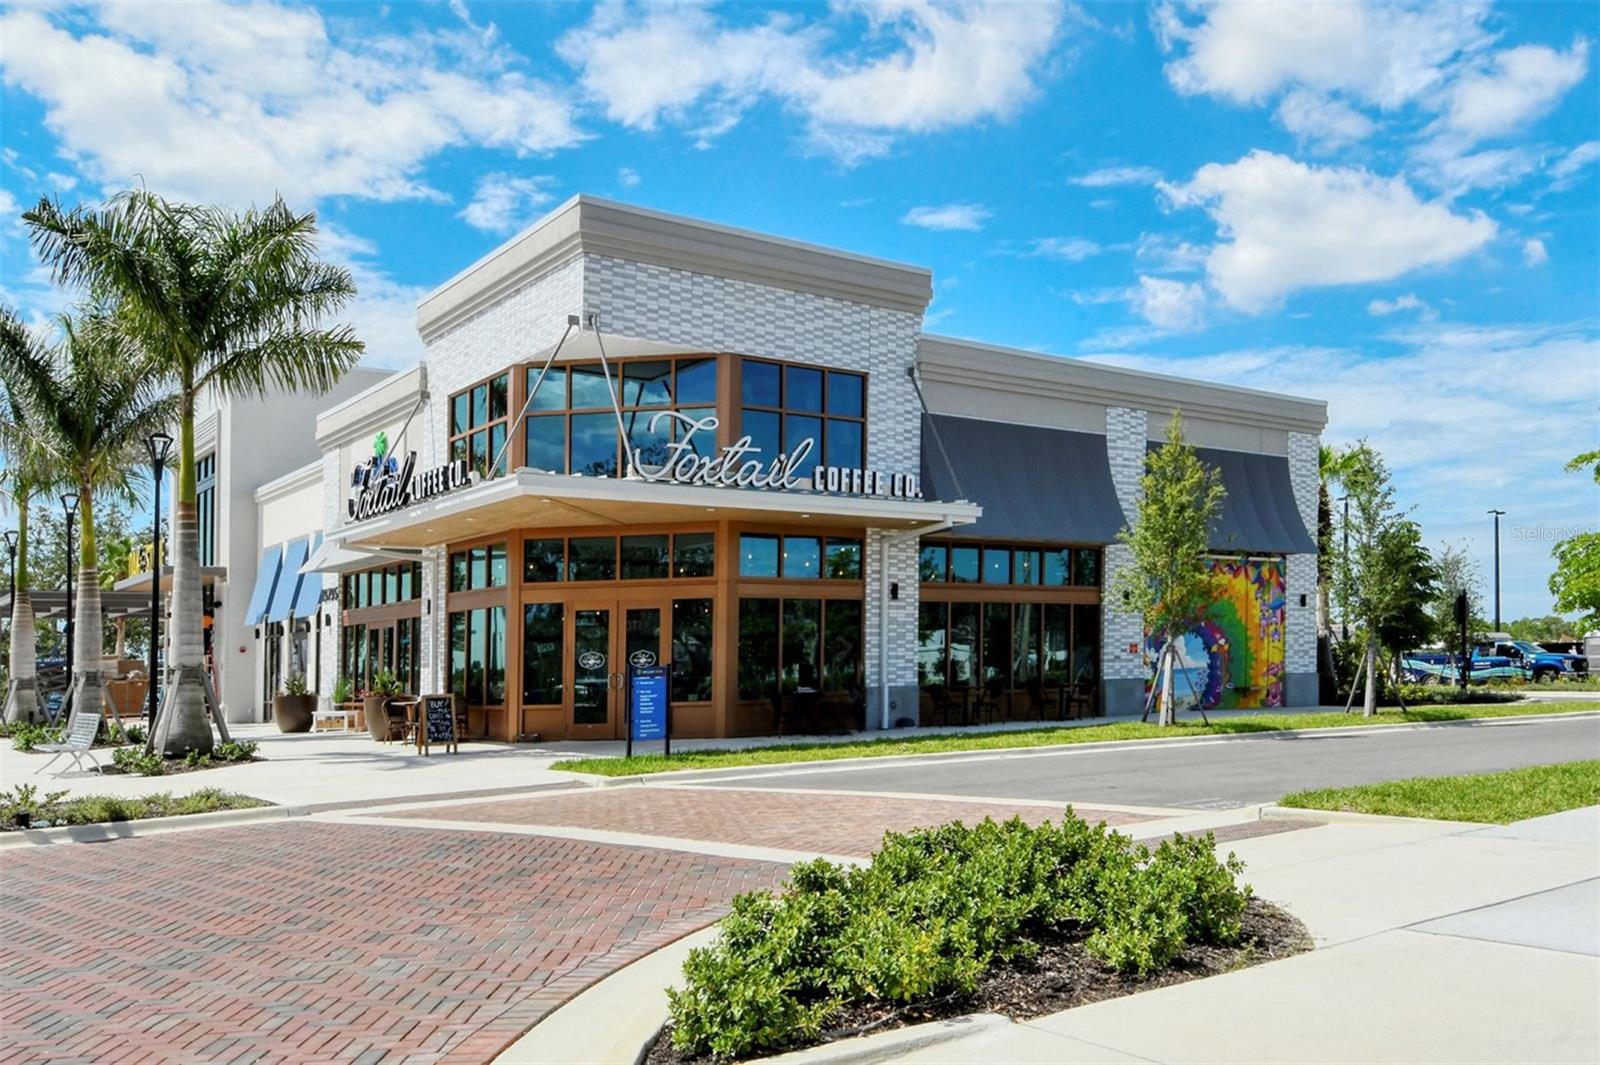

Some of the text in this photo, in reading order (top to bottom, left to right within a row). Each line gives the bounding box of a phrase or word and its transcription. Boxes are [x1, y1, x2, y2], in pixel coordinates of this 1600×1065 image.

[448, 459, 468, 488] CO.
[634, 410, 923, 498] Foxtail COFFEE CO.
